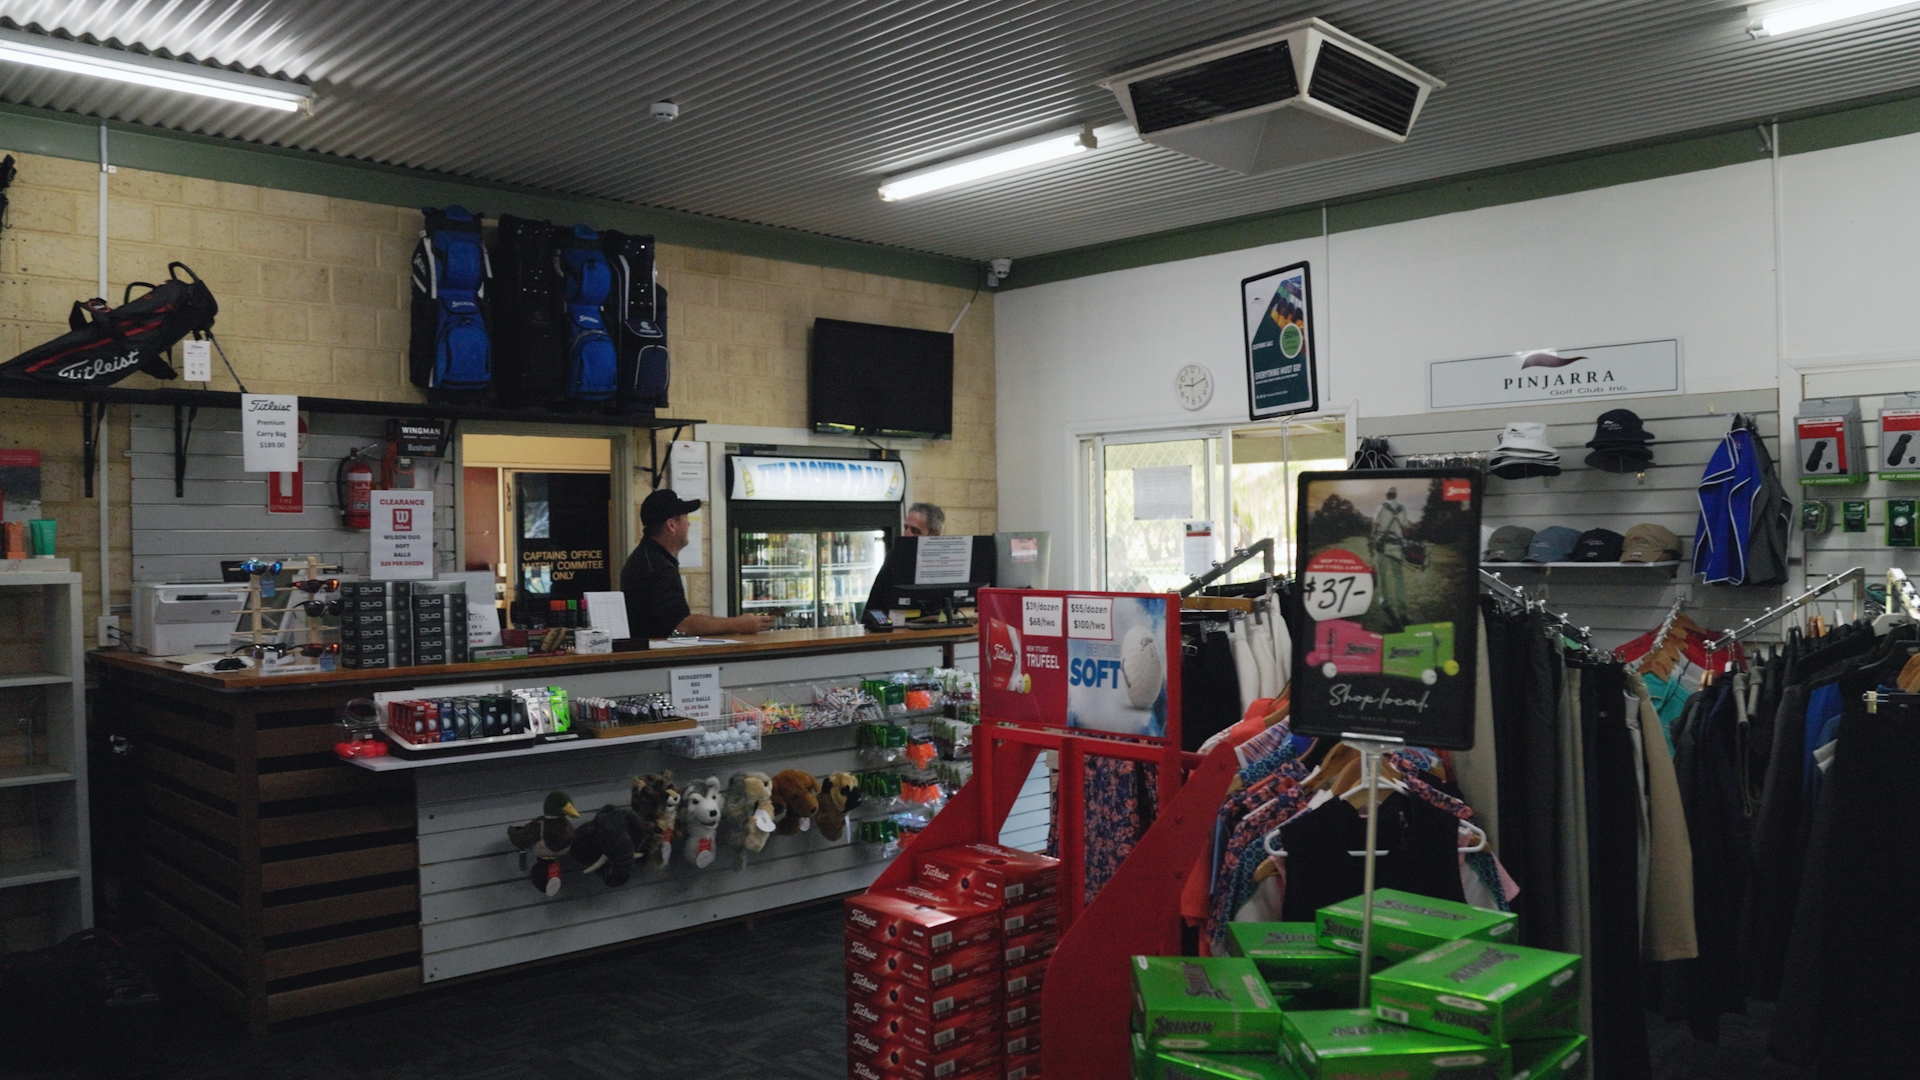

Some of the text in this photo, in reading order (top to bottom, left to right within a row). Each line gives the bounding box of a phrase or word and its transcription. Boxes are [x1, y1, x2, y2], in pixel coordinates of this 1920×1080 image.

[58, 349, 139, 380] Titleist
[1504, 370, 1615, 389] PINJARRA
[1550, 386, 1629, 400] Golf Club Inc.
[248, 400, 292, 413] Titleist
[257, 431, 287, 439] Carry Bag
[401, 427, 441, 435] WINGMAN
[407, 444, 437, 452] Bushnell
[379, 498, 425, 506] CLEARANCE
[522, 550, 603, 562] CAPTAINS OFFICE
[556, 560, 604, 571] COMMITEE
[552, 571, 575, 581] ONLY
[1026, 602, 1060, 613] $39/dozen
[1071, 603, 1108, 615] $55/dozen
[1029, 617, 1056, 628] $68/two
[1073, 619, 1106, 631] $100/two
[1086, 643, 1121, 659] BEYOND
[1026, 654, 1060, 670] TRUFEEL
[1070, 658, 1121, 689] SOFT
[1329, 683, 1376, 711] Shop
[924, 864, 951, 882] Titleist
[851, 909, 878, 930] Titleist
[851, 941, 878, 961] Titleist
[853, 972, 879, 992] Titleist
[853, 1002, 880, 1023] Titleist
[854, 1032, 880, 1053] Titleist
